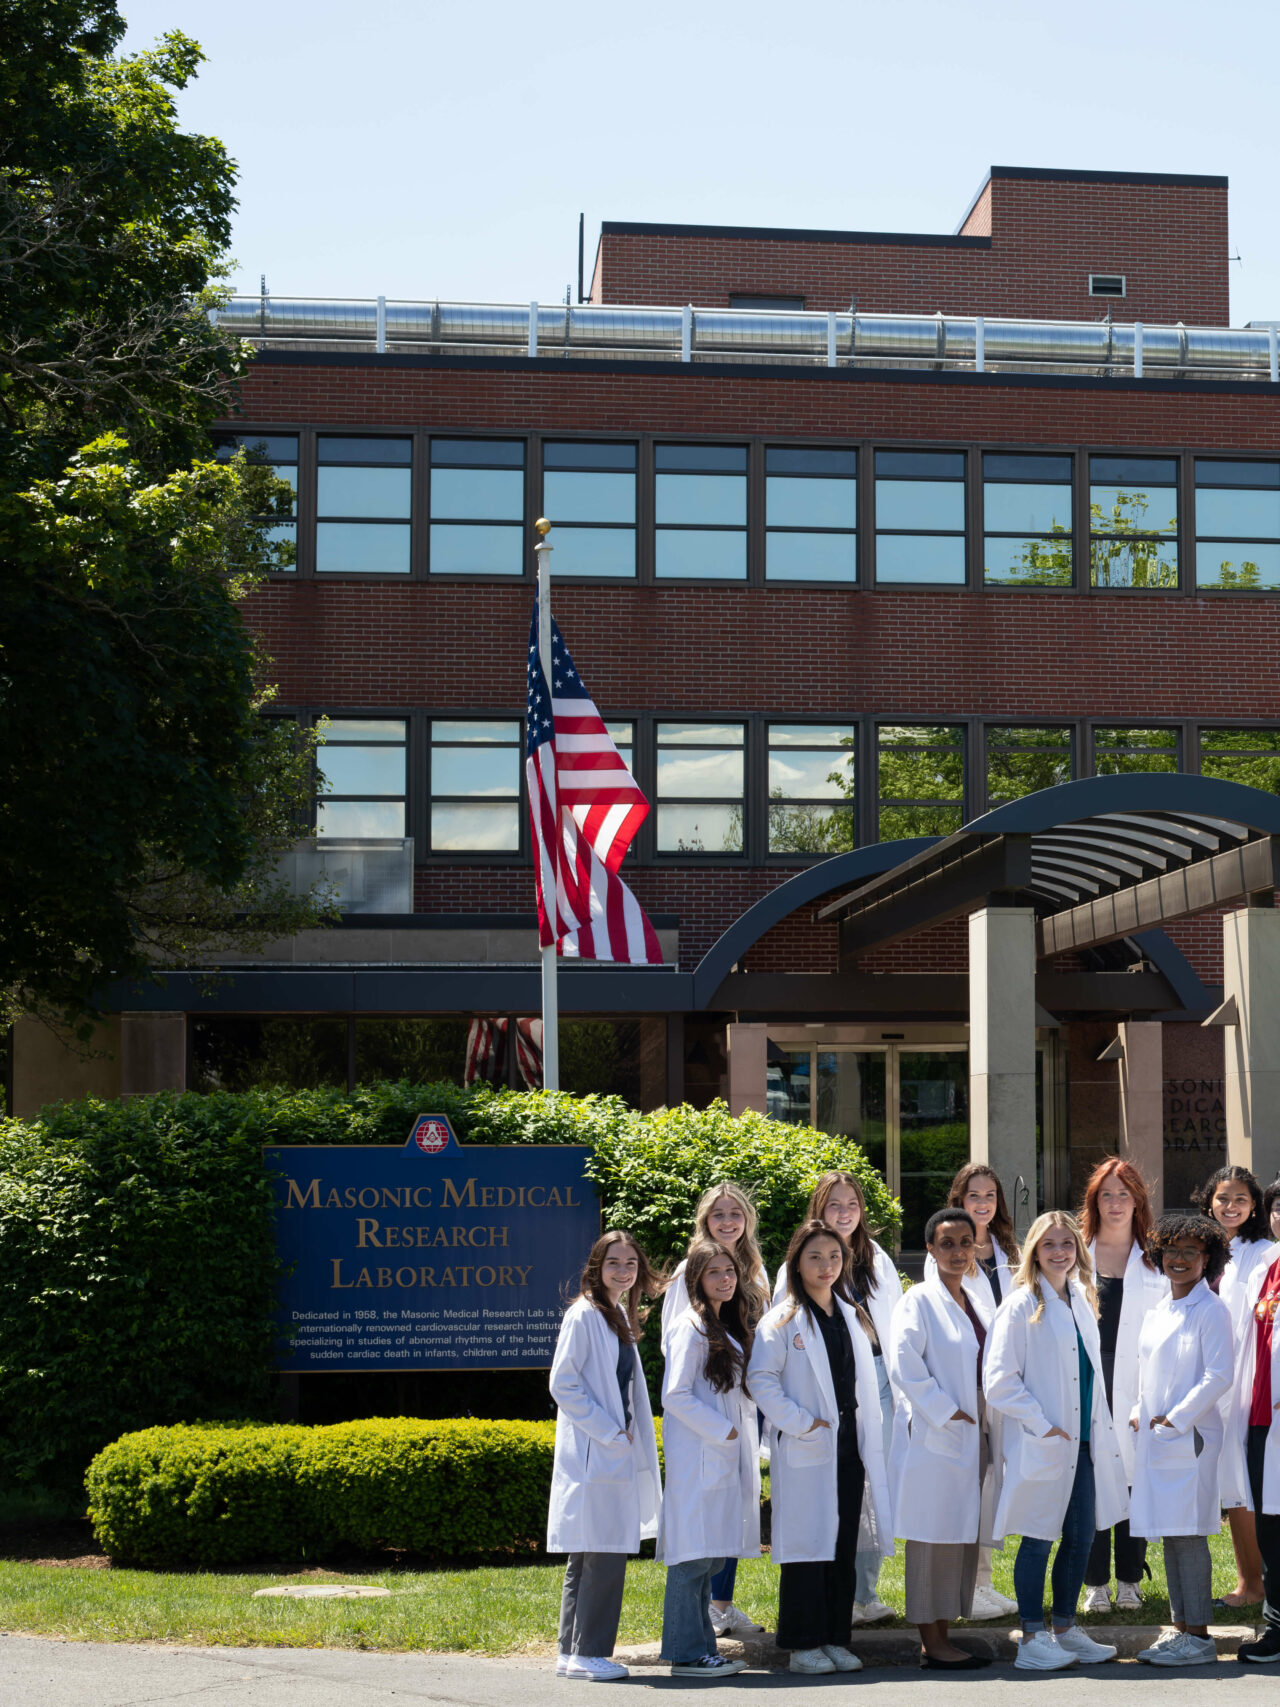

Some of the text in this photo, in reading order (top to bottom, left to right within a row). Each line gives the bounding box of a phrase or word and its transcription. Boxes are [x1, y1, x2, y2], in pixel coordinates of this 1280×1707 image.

[284, 1178, 581, 1209] MASONIC MEDICAL
[356, 1218, 510, 1248] RESEARCH
[330, 1258, 533, 1288] LABORATORY
[292, 1311, 339, 1320] Dedicated
[342, 1311, 351, 1319] in
[354, 1310, 379, 1320] 1958,
[383, 1310, 397, 1319] the
[401, 1310, 440, 1319] Masonic
[443, 1309, 479, 1318] Medical
[482, 1309, 525, 1318] Research
[527, 1309, 544, 1317] Lab
[547, 1309, 555, 1317] is
[299, 1321, 561, 1333] internationally renowned cardiovascular research institute
[289, 1337, 342, 1347] specializing
[346, 1337, 354, 1345] in
[358, 1336, 391, 1345] studies
[395, 1335, 405, 1345] of
[408, 1335, 451, 1345] abnormal
[455, 1335, 492, 1345] rhythms
[496, 1334, 506, 1343] of
[509, 1334, 524, 1343] the
[527, 1334, 551, 1343] heart
[310, 1347, 552, 1359] sudden cardiac death in infants, children and adults.
